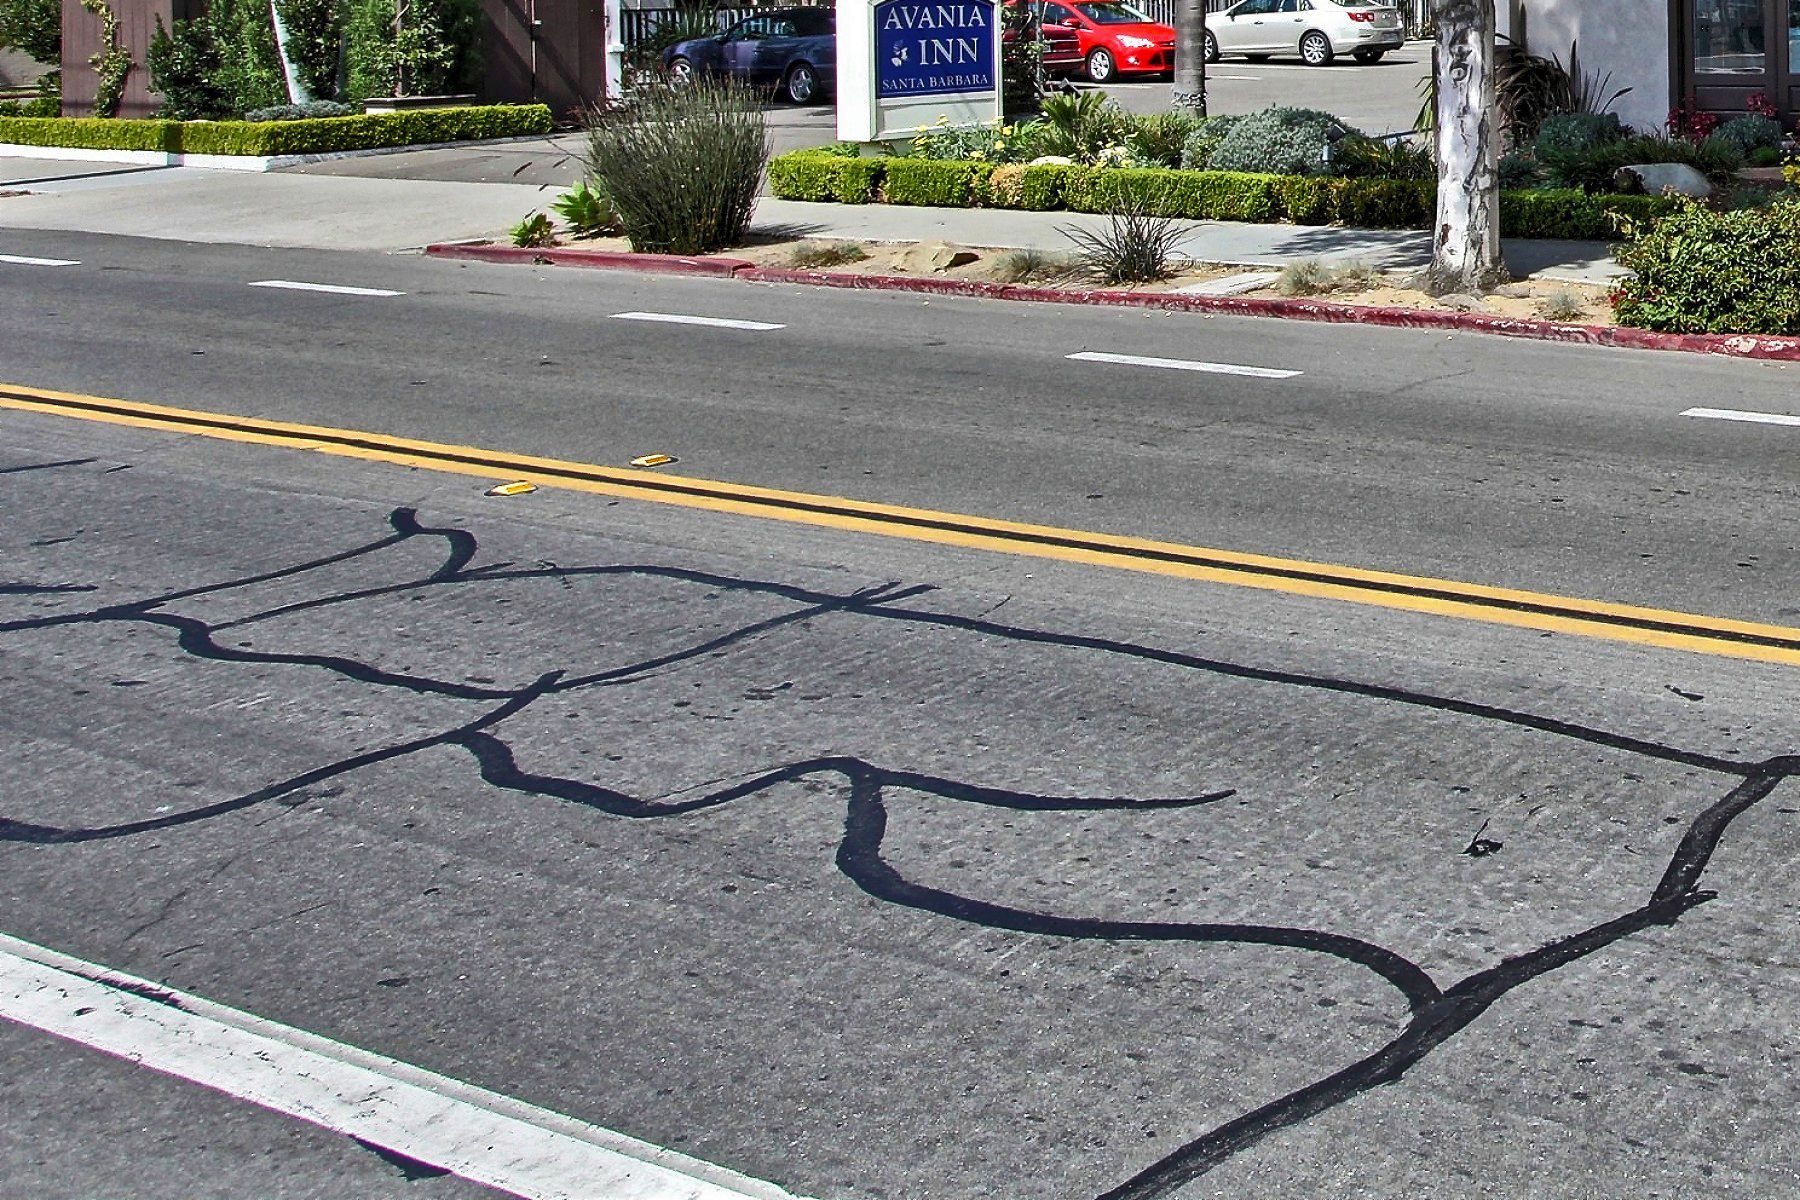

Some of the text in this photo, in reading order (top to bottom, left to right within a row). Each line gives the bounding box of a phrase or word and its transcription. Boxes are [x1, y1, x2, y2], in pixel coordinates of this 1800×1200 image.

[883, 5, 986, 30] AVANIA
[918, 37, 979, 65] INN
[882, 73, 988, 90] SANTA BARBARA
